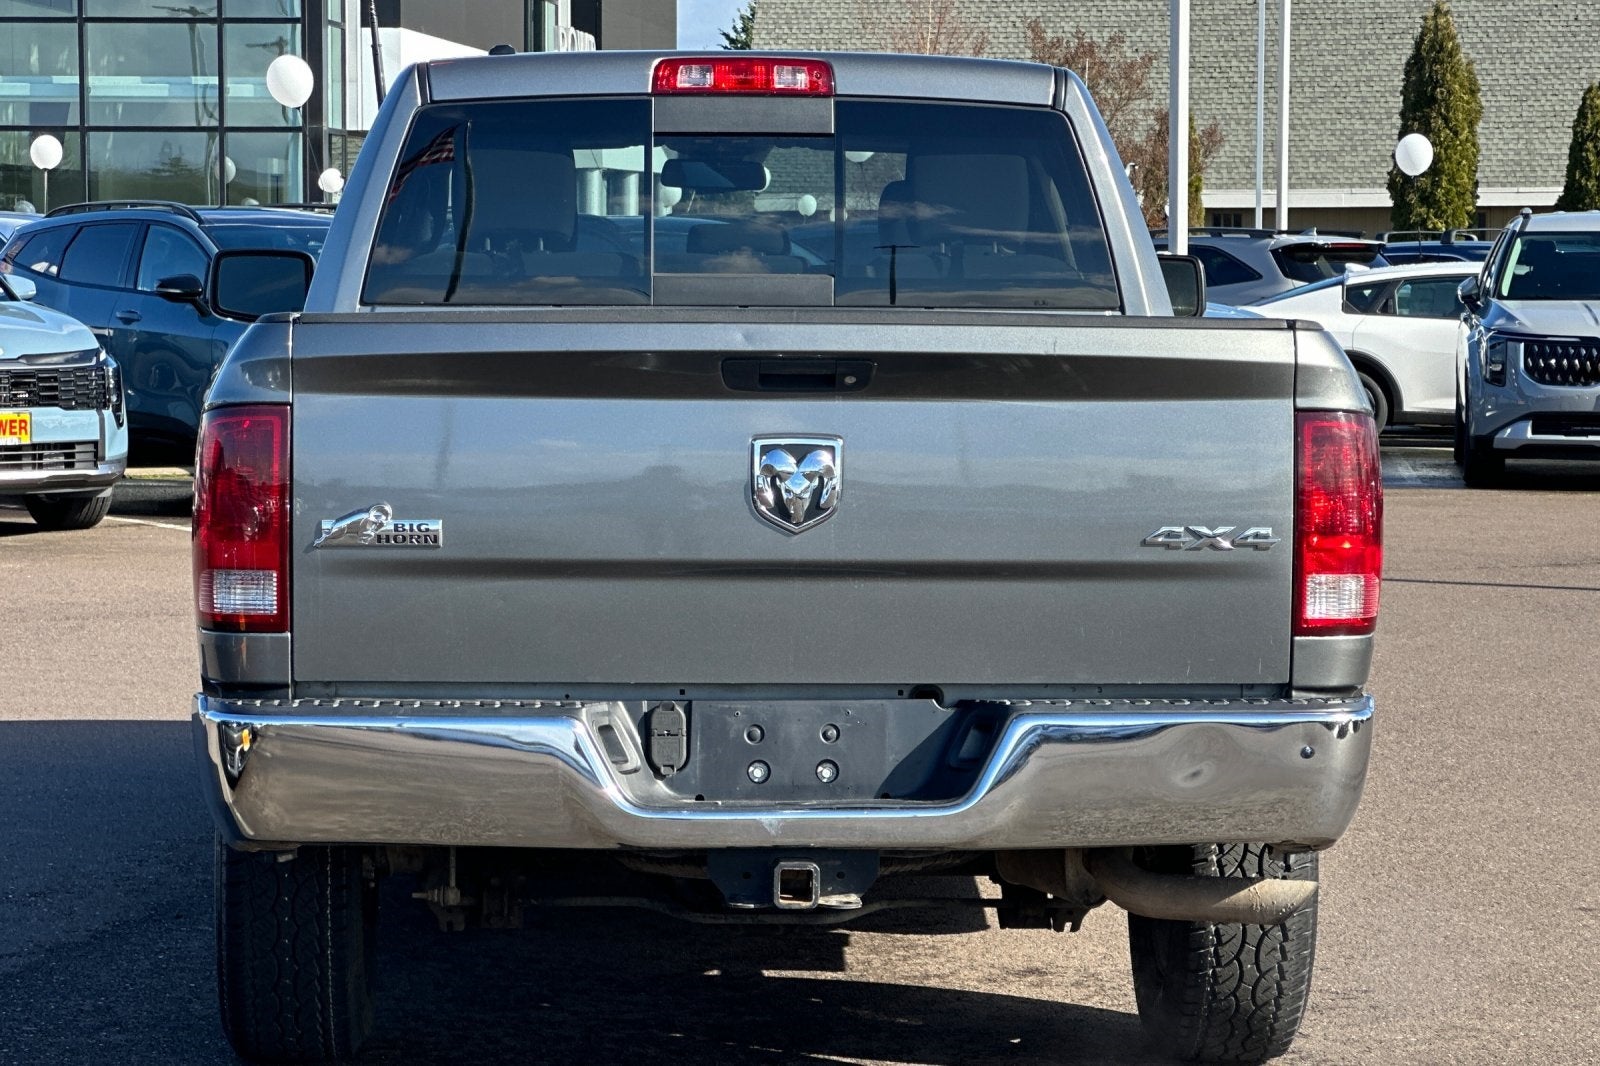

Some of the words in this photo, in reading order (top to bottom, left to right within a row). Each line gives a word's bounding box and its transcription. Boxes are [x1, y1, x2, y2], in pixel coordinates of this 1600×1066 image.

[393, 522, 430, 533] BIG
[376, 534, 438, 544] HORN
[1143, 525, 1281, 551] 4X4
